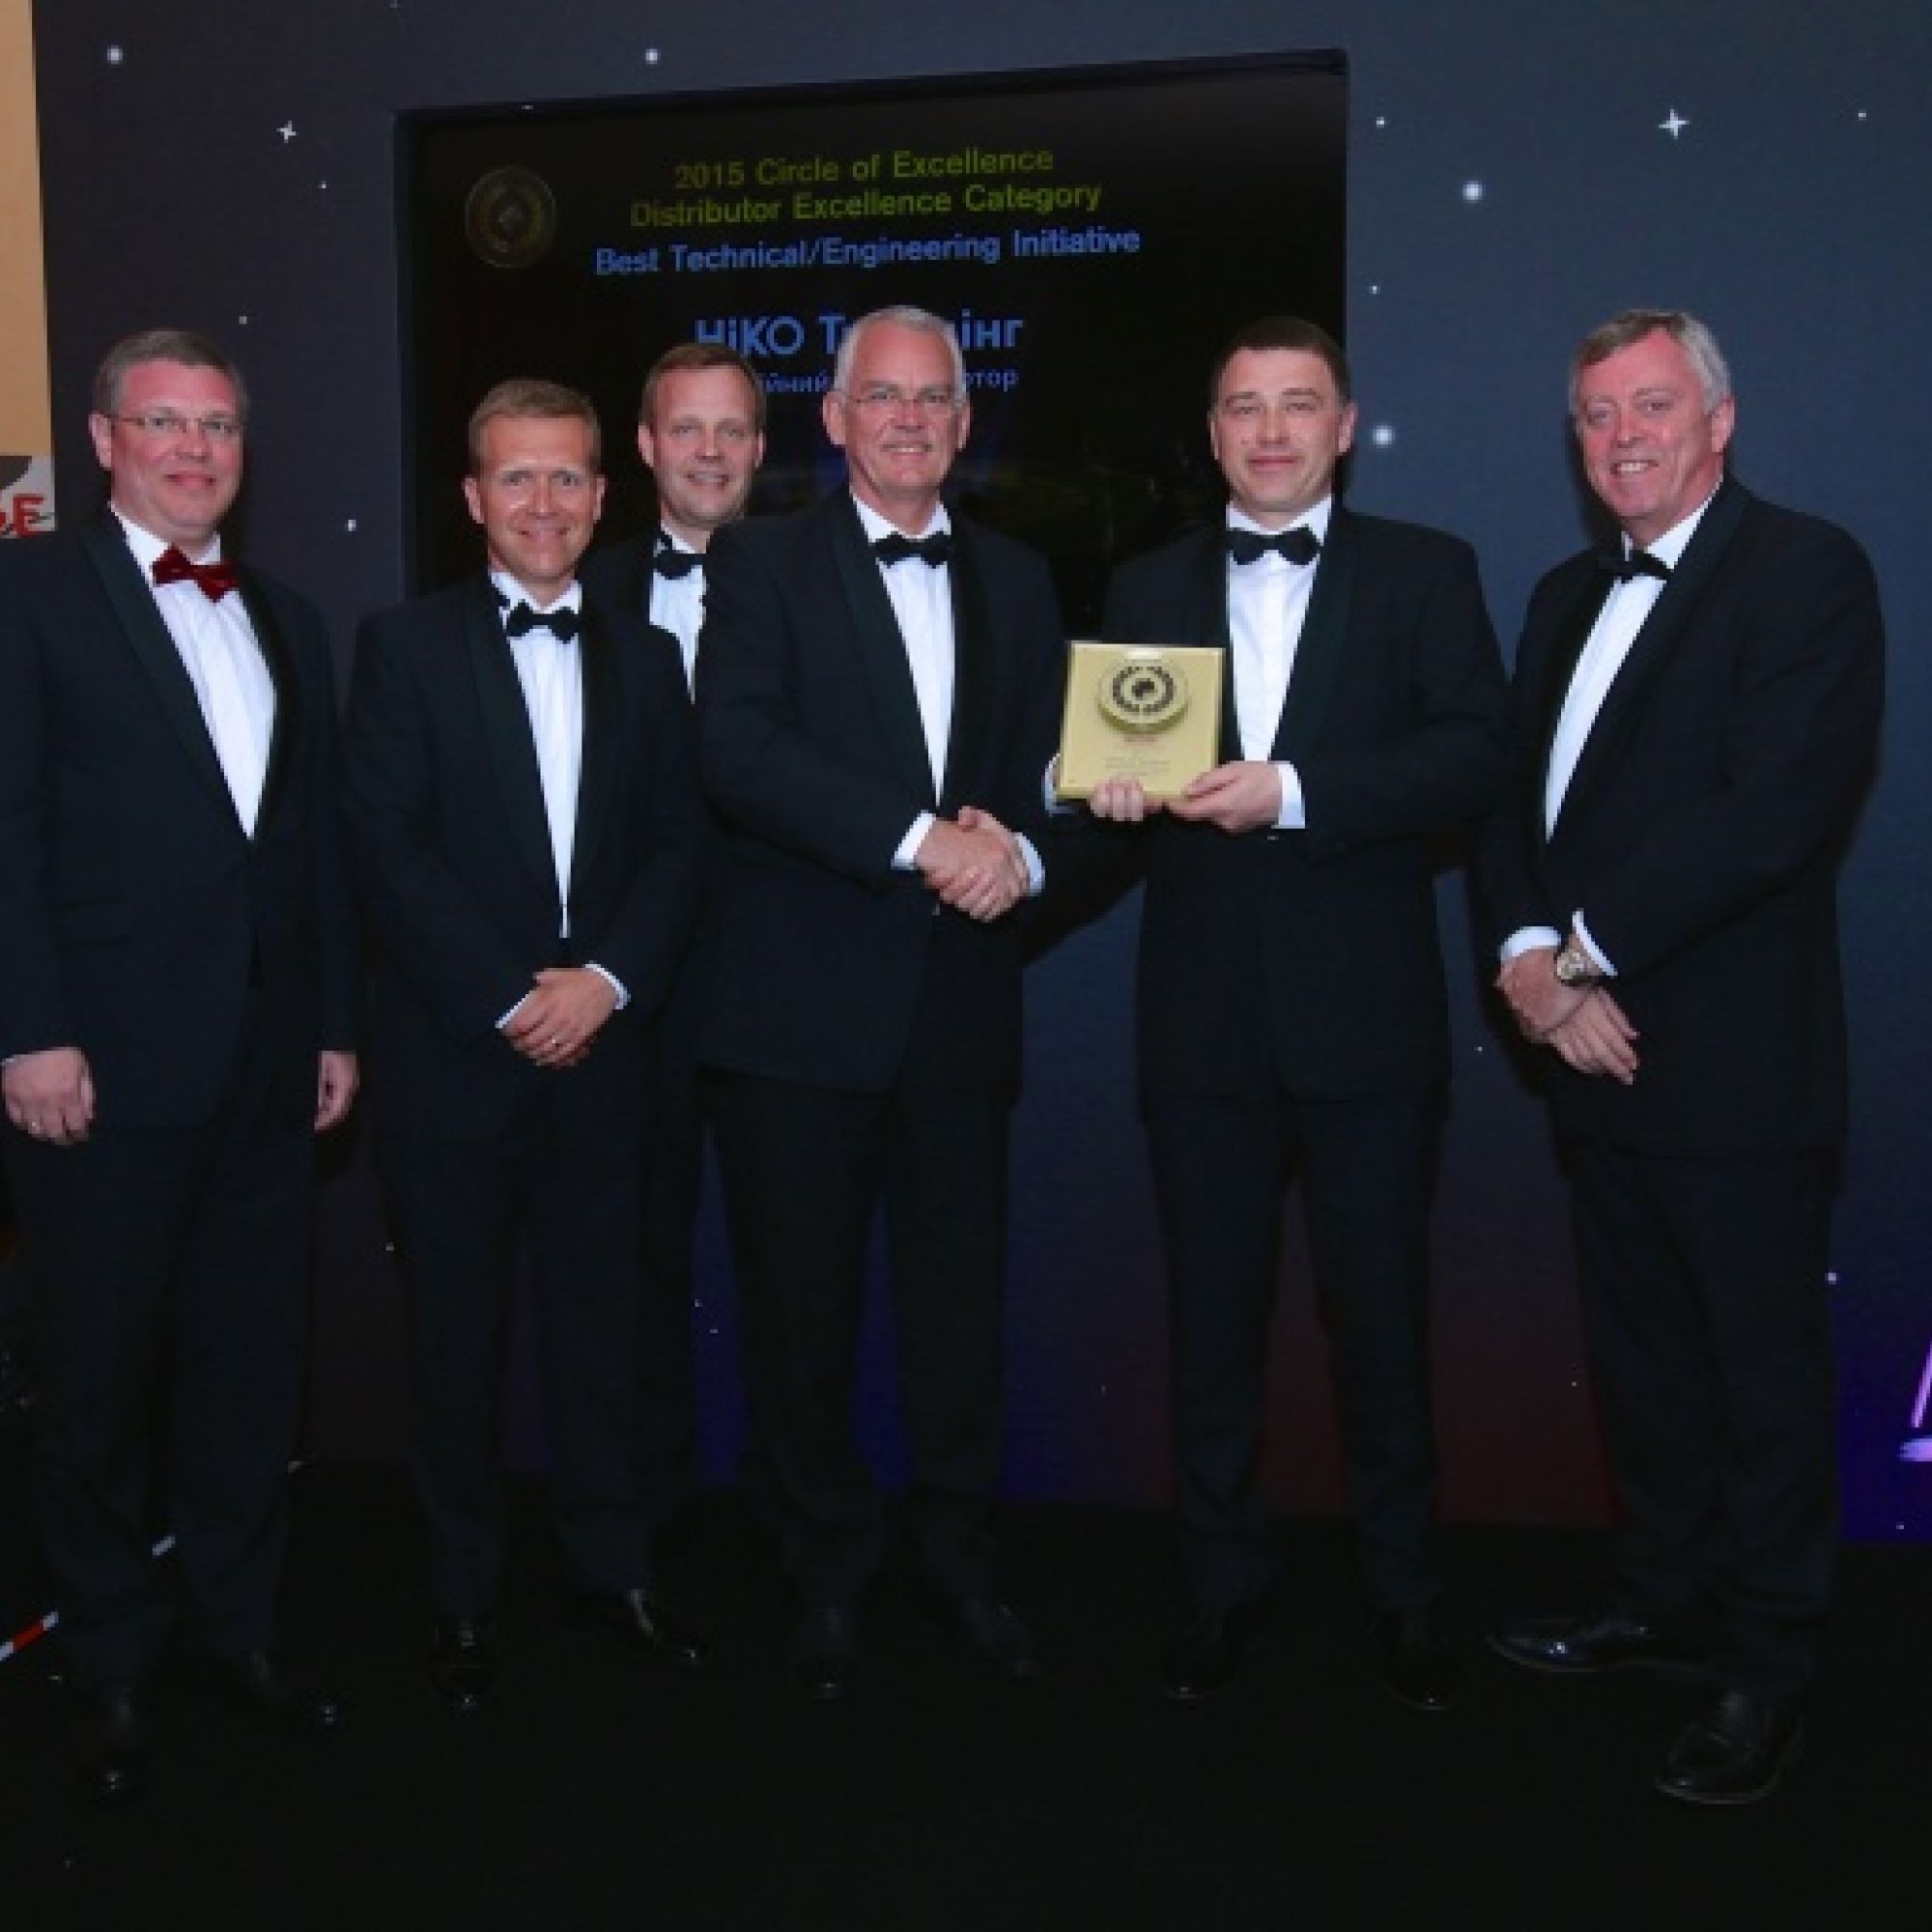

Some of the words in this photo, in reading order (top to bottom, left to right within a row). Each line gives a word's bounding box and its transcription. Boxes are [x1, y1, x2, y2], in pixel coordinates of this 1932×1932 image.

[675, 160, 745, 188] 2015
[757, 156, 839, 185] Circle
[850, 153, 881, 181] of
[894, 146, 1054, 178] Excellence
[630, 195, 782, 227] Distributor
[792, 188, 952, 220] Excellence
[965, 184, 1103, 215] Category
[595, 246, 661, 275] Best
[668, 232, 1001, 272] Technical/Engineering
[1012, 225, 1141, 257] Initiative
